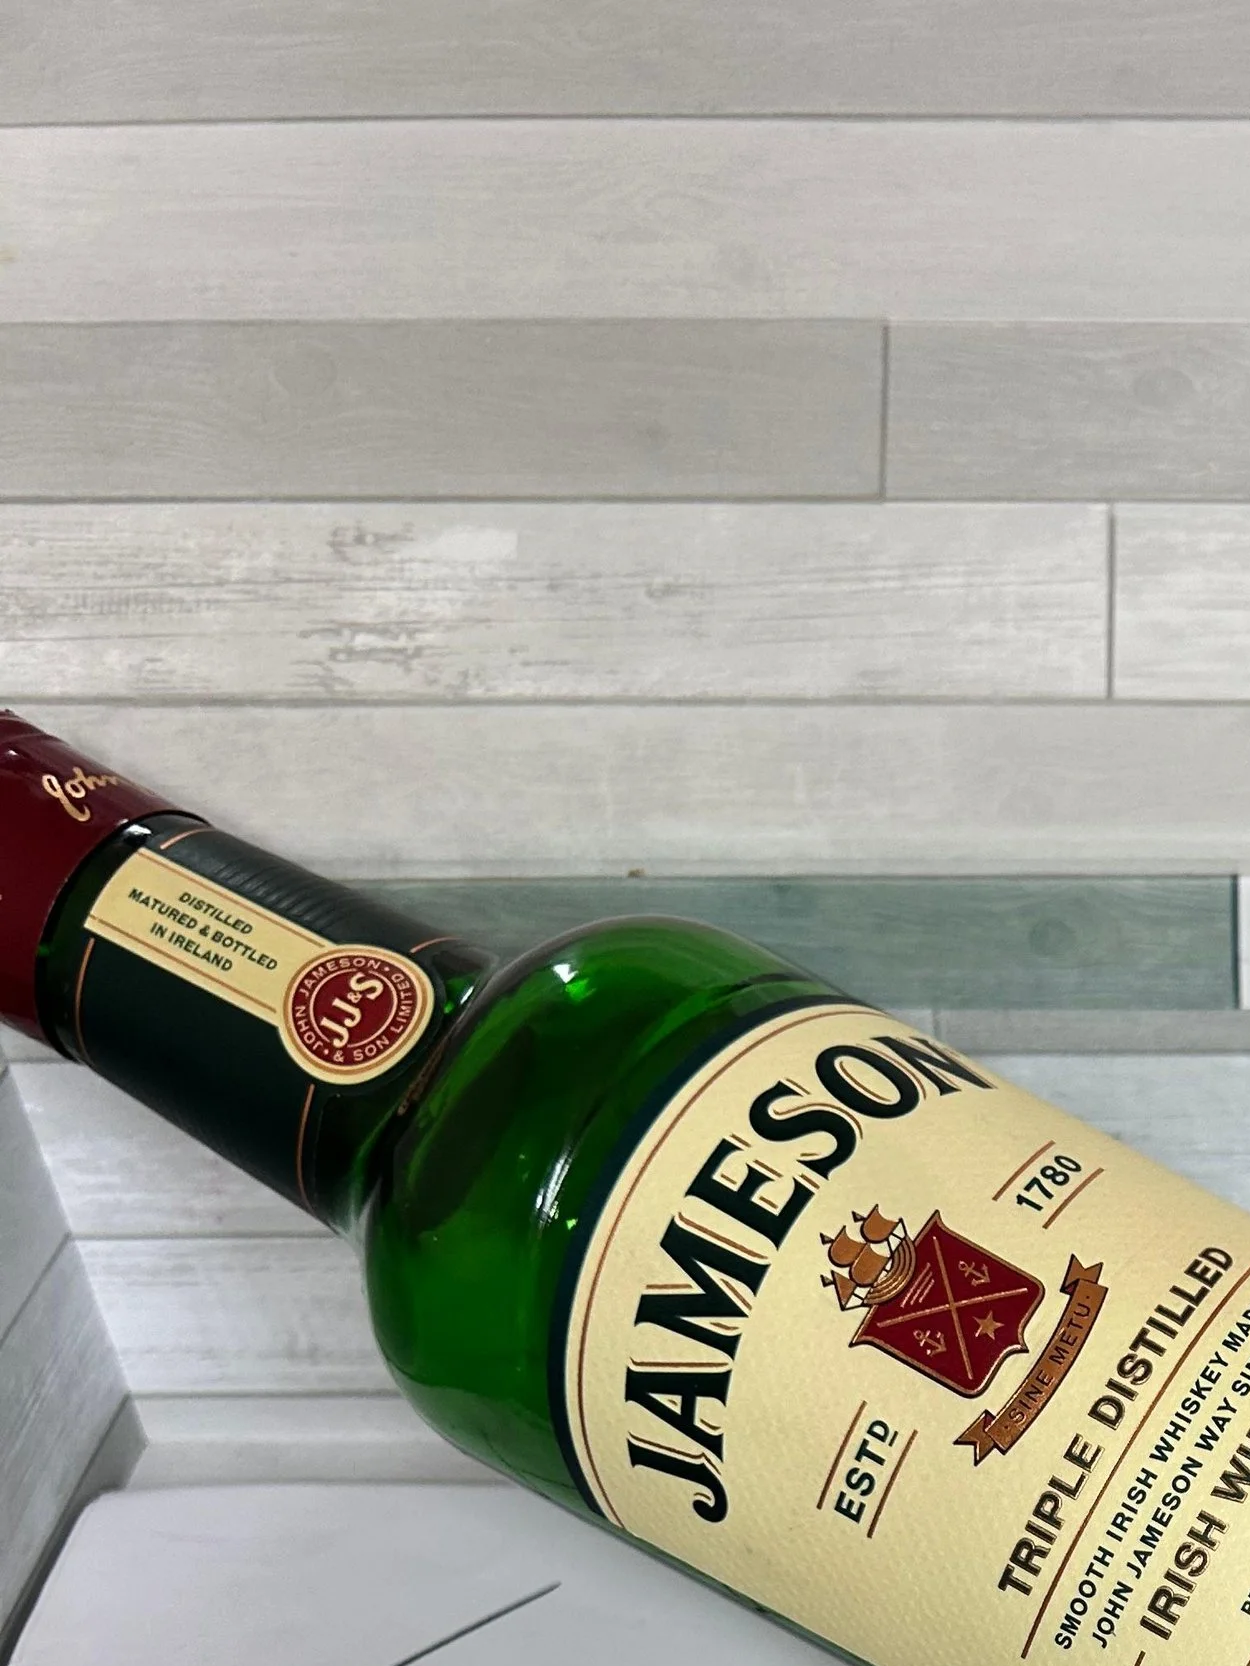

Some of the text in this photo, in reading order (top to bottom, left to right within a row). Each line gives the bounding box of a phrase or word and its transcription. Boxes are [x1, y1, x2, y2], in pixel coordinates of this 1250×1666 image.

[128, 888, 278, 970] MATURED & BOTTLED
[150, 922, 233, 971] IN IRELAND
[178, 891, 253, 934] DISTILLED
[295, 957, 381, 1051] JOHN JAMESON
[353, 1035, 390, 1061] SON
[390, 973, 413, 1034] LIMITED
[1015, 1153, 1083, 1214] 1780
[624, 1034, 1000, 1524] JAMESON
[998, 1246, 1234, 1596] TRIPLE DISTILLED
[1008, 1369, 1054, 1424] SINE
[834, 1418, 899, 1524] ESTD
[1054, 1545, 1114, 1650] SMOOTH
[1105, 1467, 1158, 1543] IRISH
[1149, 1351, 1230, 1464] WHISKEY
[1091, 1581, 1134, 1650] JOHN
[1126, 1456, 1201, 1580] JAMESON
[1194, 1397, 1238, 1453] WAY
[1139, 1508, 1230, 1641] IRISH
